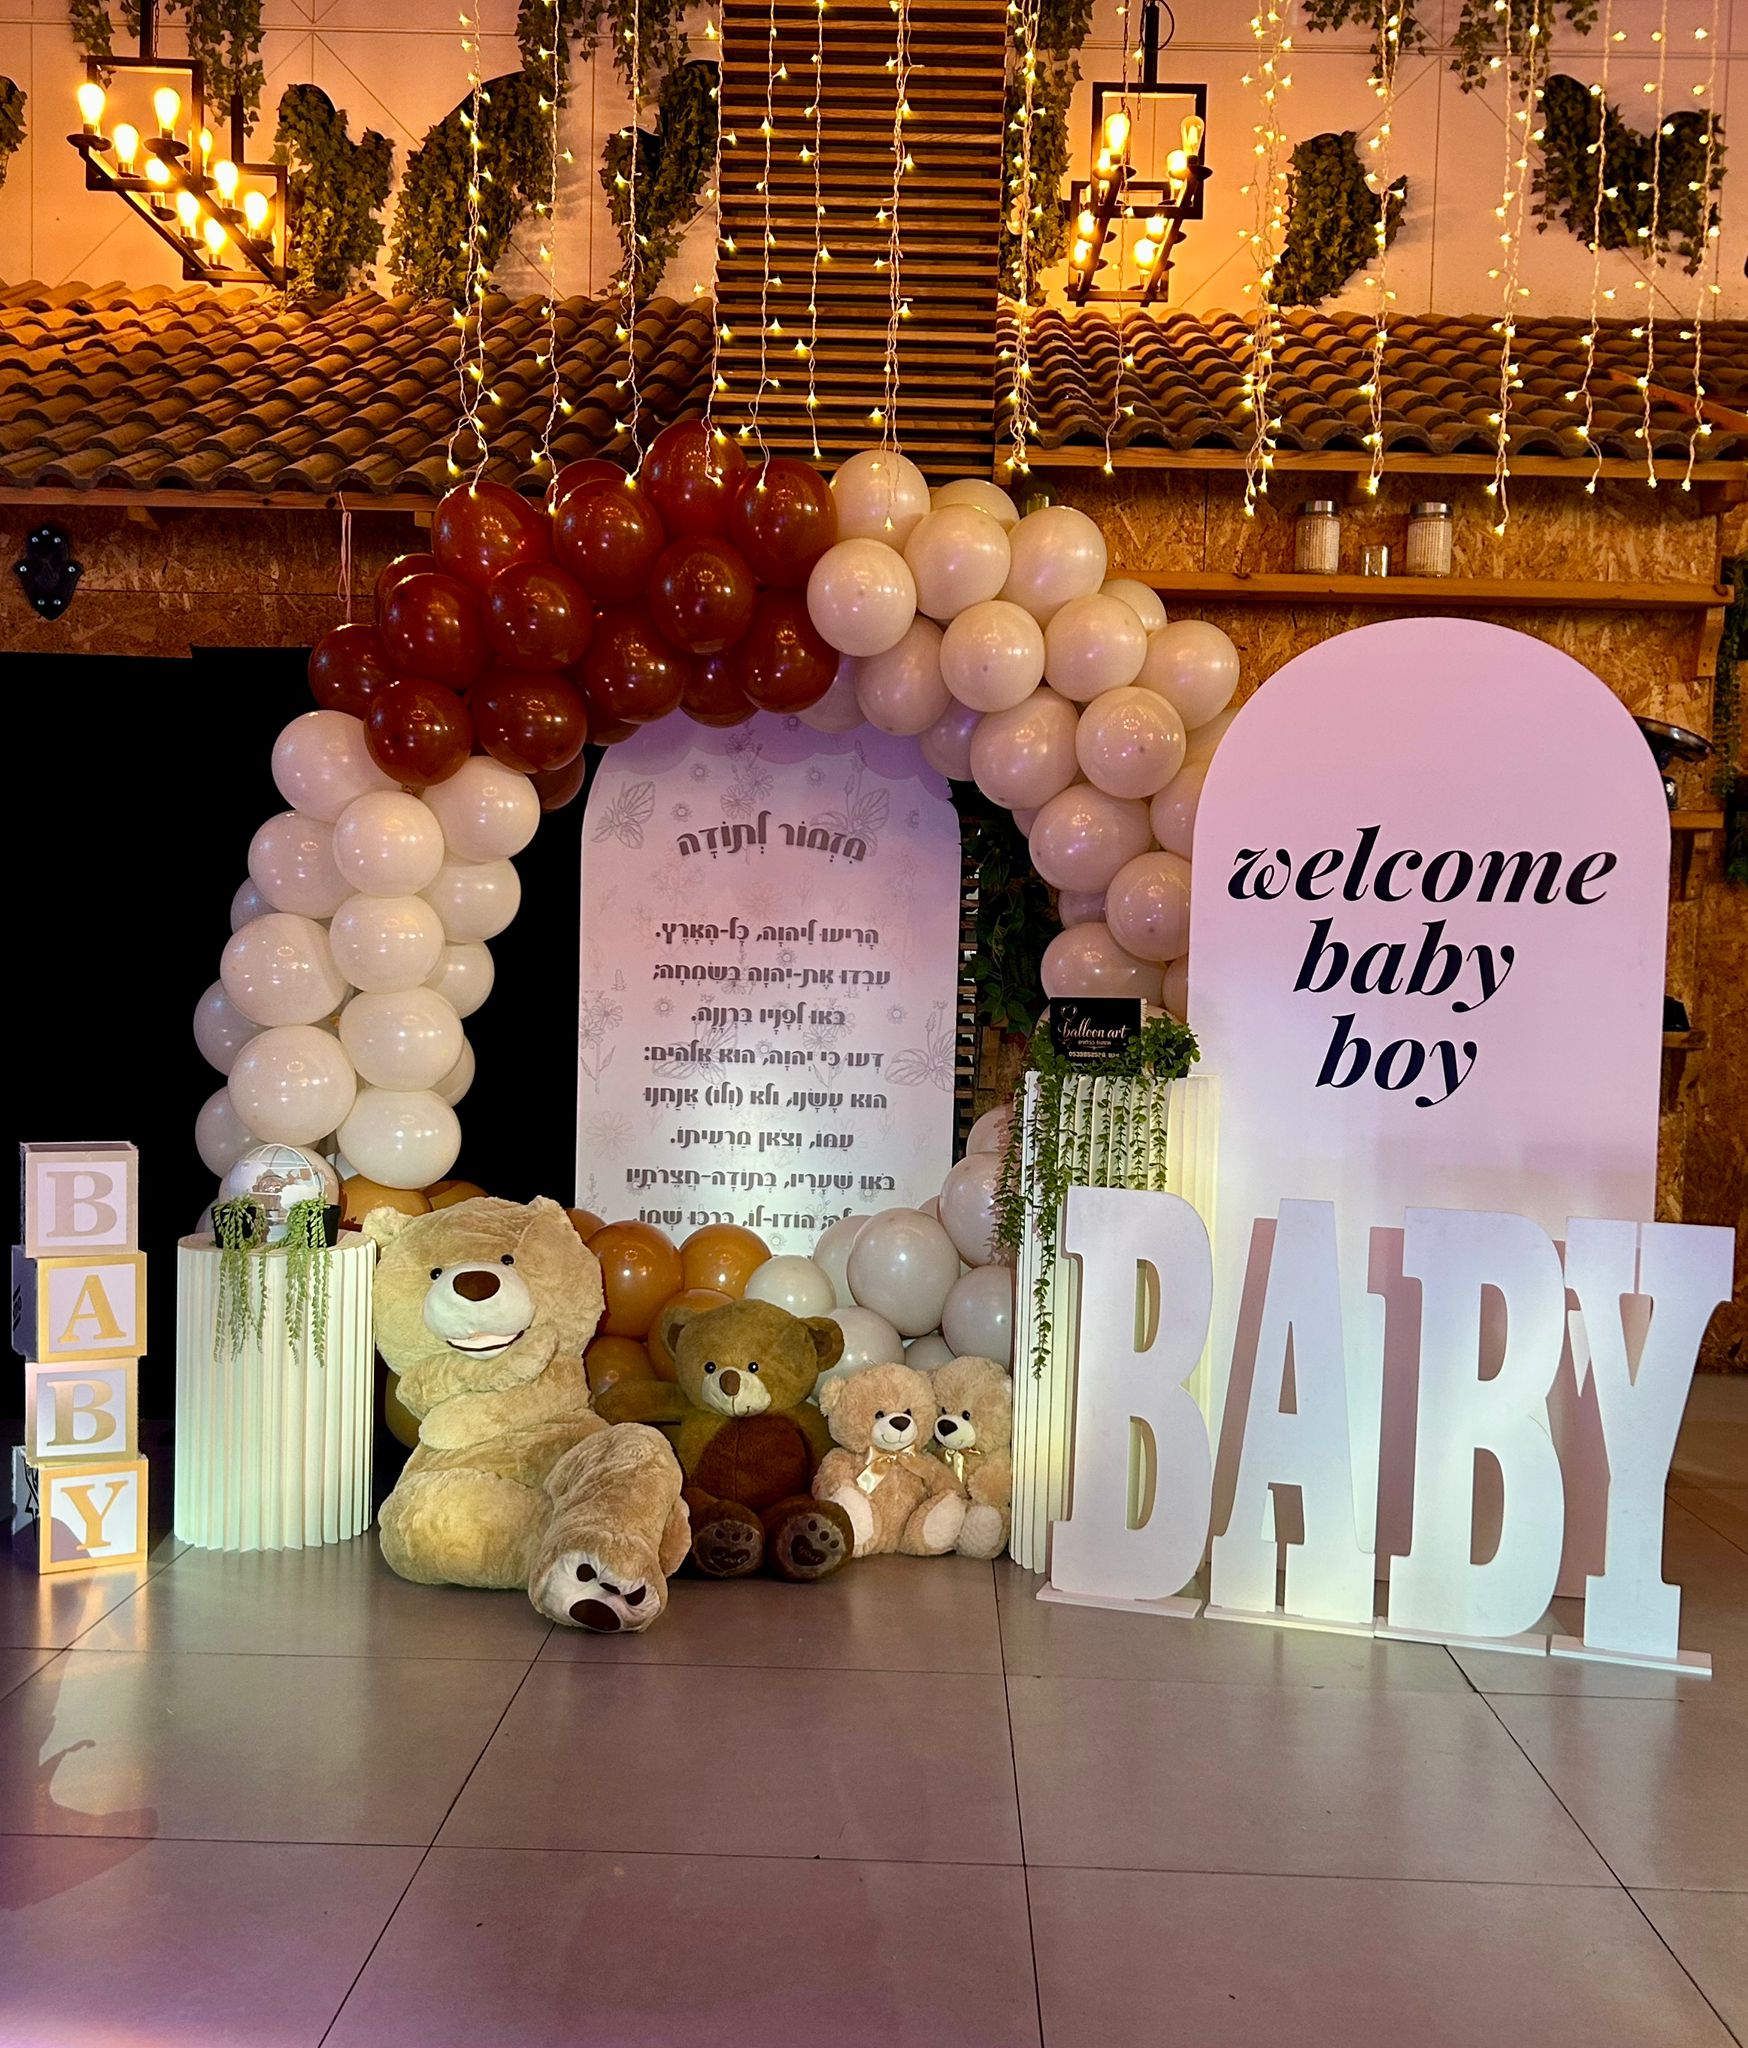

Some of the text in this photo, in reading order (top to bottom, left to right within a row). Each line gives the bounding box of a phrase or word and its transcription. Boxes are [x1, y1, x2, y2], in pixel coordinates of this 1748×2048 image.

[1227, 825, 1618, 906] welcome
[1293, 918, 1516, 1013] baby
[1058, 1018, 1131, 1039] balloon art
[1315, 1014, 1478, 1108] boy
[1050, 1185, 1736, 1660] BABY
